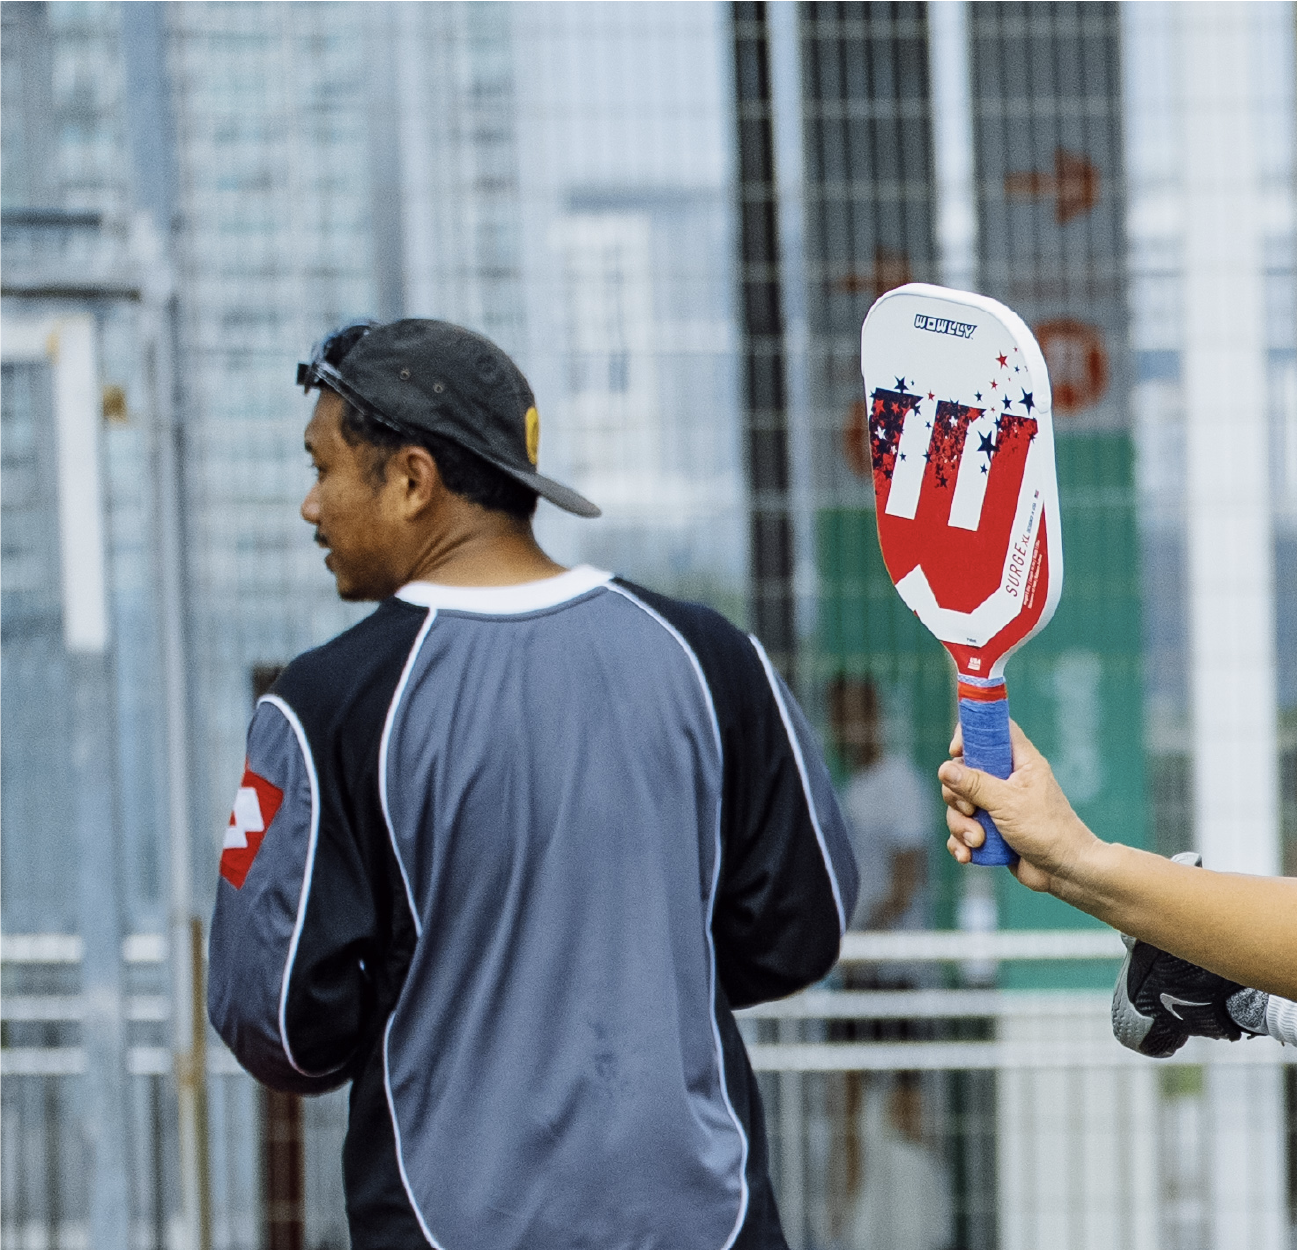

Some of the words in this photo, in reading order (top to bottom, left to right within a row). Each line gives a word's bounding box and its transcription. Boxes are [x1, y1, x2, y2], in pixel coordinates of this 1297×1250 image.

[914, 314, 978, 339] WOWLLY
[1005, 542, 1027, 597] SURGE
[1021, 534, 1031, 548] XL
